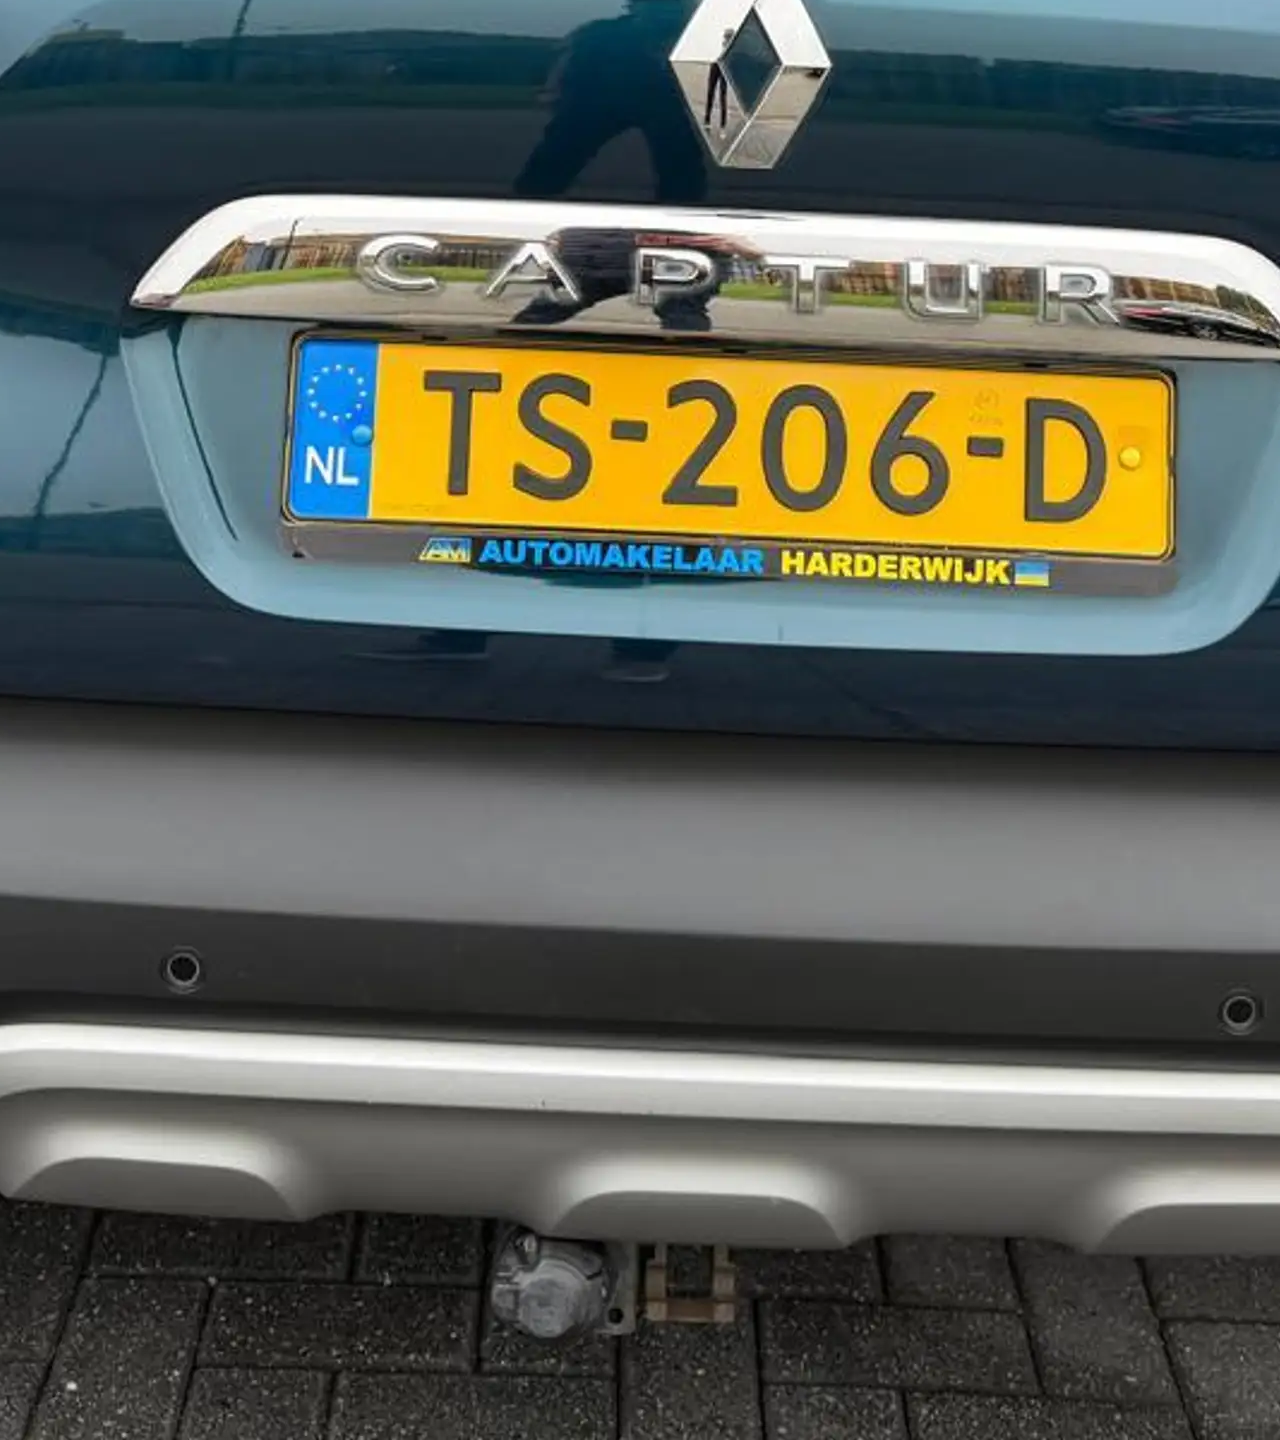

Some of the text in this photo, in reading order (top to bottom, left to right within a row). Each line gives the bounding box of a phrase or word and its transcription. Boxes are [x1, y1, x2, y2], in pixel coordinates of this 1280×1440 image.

[358, 233, 1123, 328] CAPTUR
[304, 446, 359, 485] NL
[423, 370, 1108, 524] TS-206-D
[478, 538, 1012, 585] AUTOMAKELAAR HARDERWIJK
